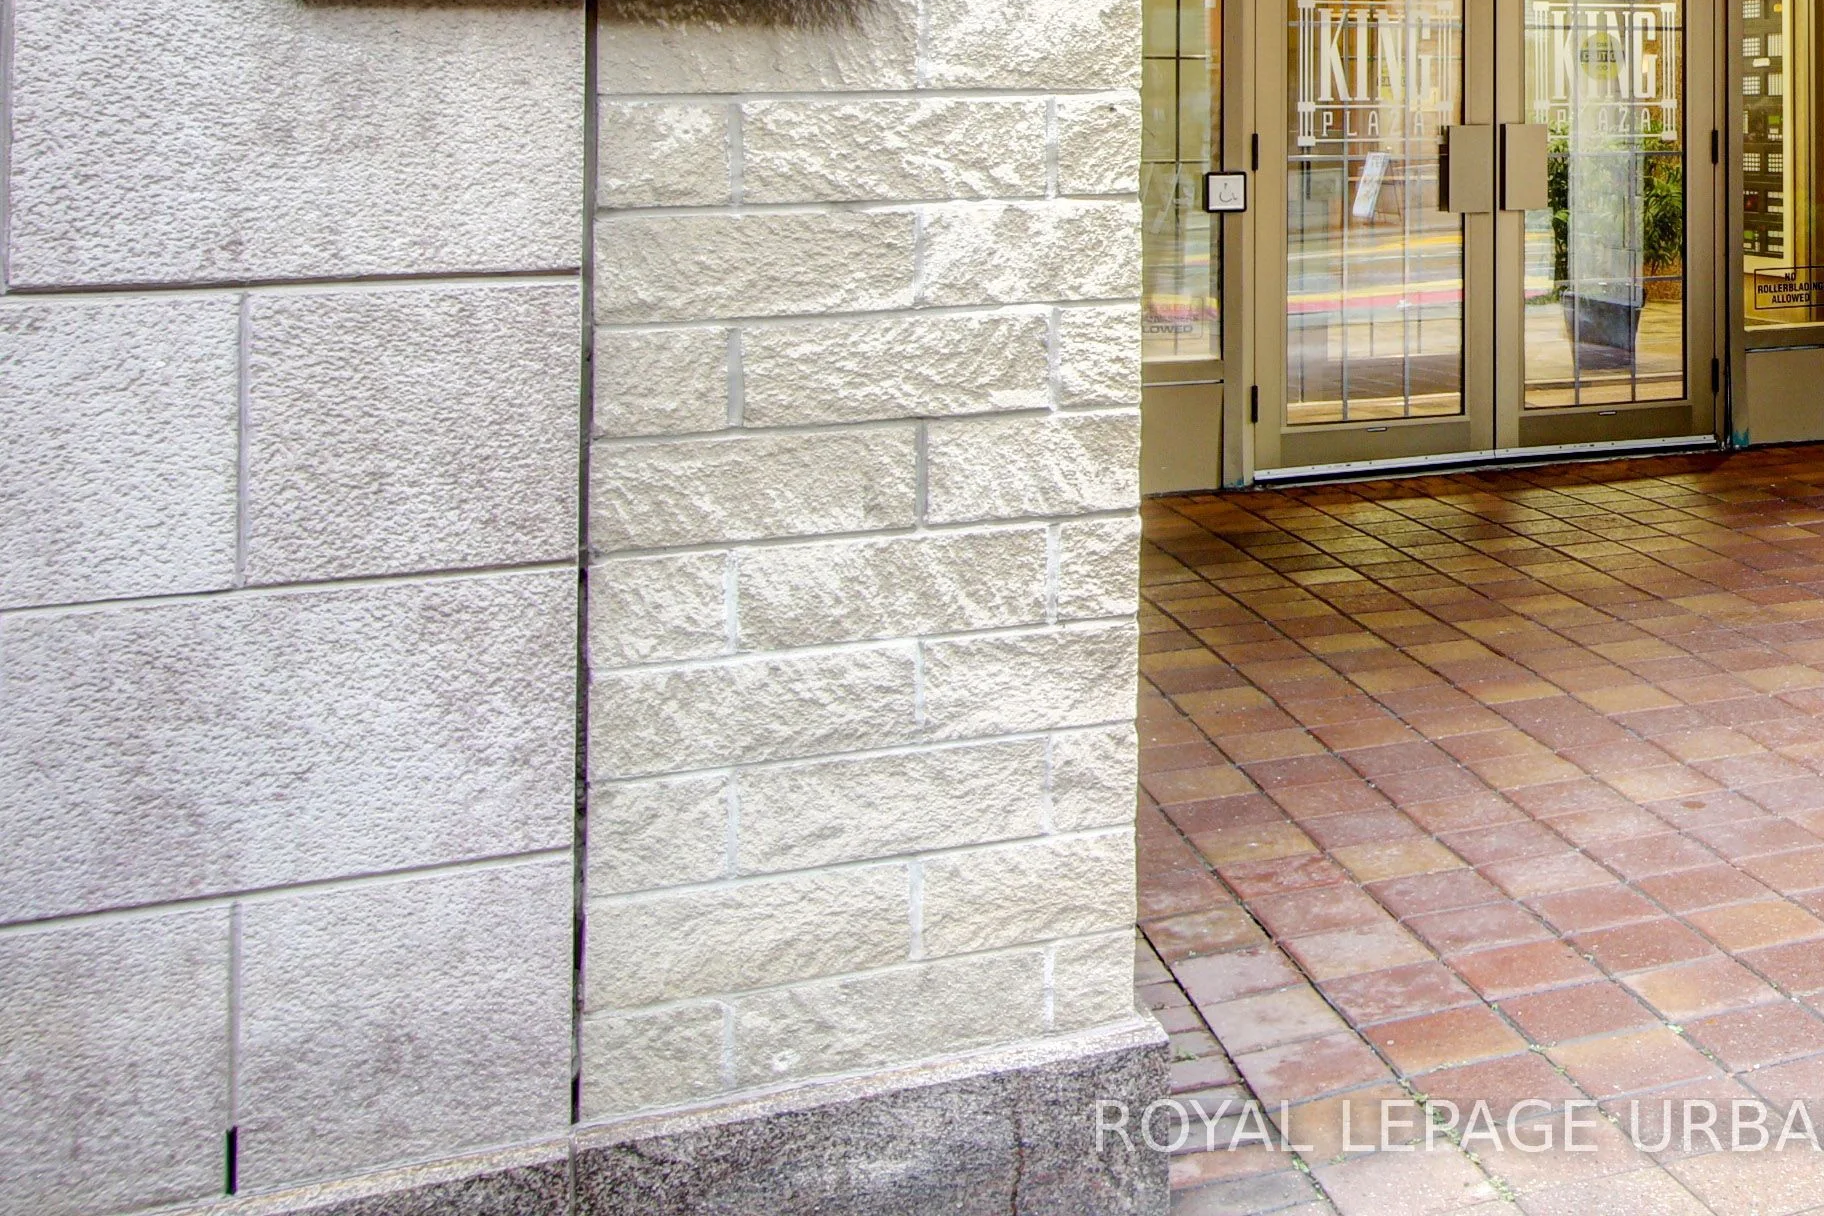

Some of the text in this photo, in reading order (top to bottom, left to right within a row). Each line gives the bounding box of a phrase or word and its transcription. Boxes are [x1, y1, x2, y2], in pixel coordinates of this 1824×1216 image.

[1318, 8, 1431, 101] KING
[1551, 10, 1658, 99] KING
[1322, 111, 1424, 137] PLAZA
[1556, 107, 1651, 133] PAZA
[1784, 273, 1796, 281] NO
[1757, 282, 1824, 294] ROLLERBLADING
[1772, 293, 1811, 304] ALLOWED
[1142, 325, 1193, 334] LOWED
